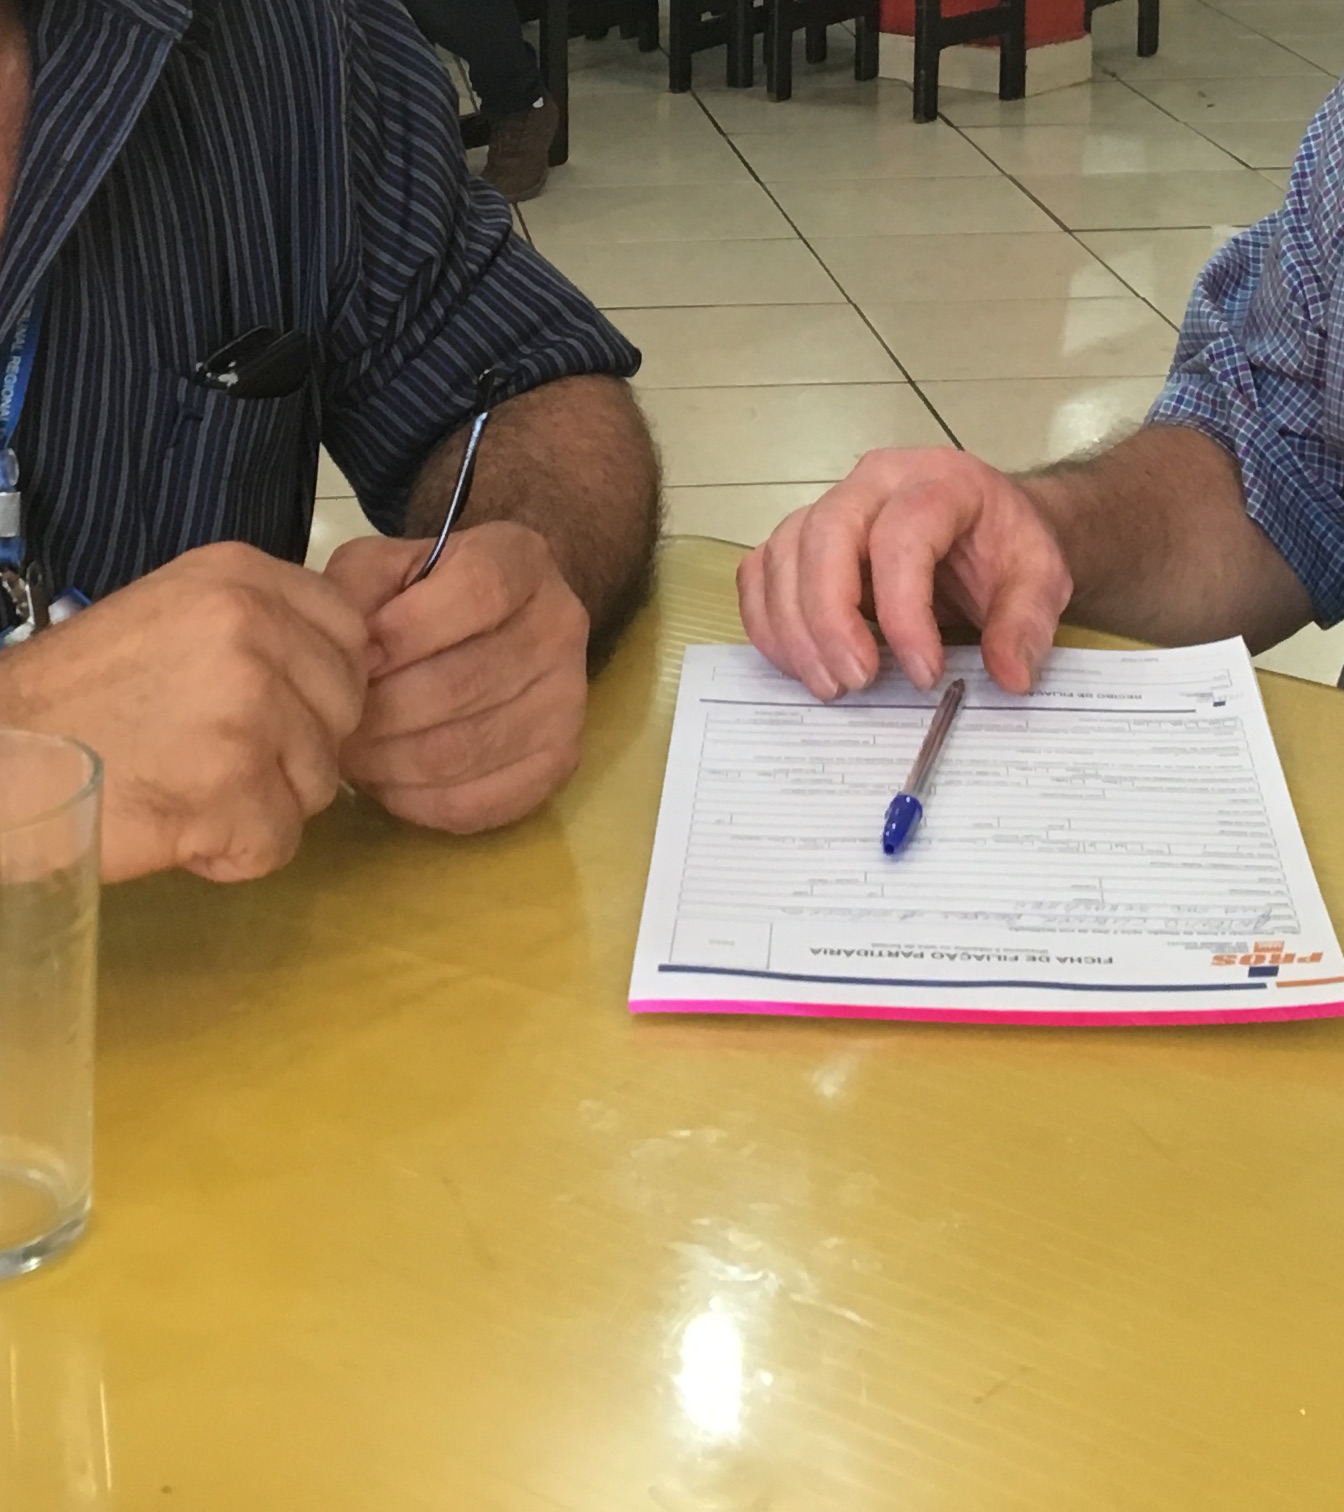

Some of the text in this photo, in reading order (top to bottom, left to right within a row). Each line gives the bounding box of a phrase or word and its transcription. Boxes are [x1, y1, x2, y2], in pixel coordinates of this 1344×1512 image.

[809, 947, 925, 959] PARTIDÁRIA
[930, 951, 1019, 964] FILIAÇÃO
[1025, 954, 1051, 964] DE
[1055, 955, 1114, 965] FICHA
[1211, 952, 1324, 967] PROS
